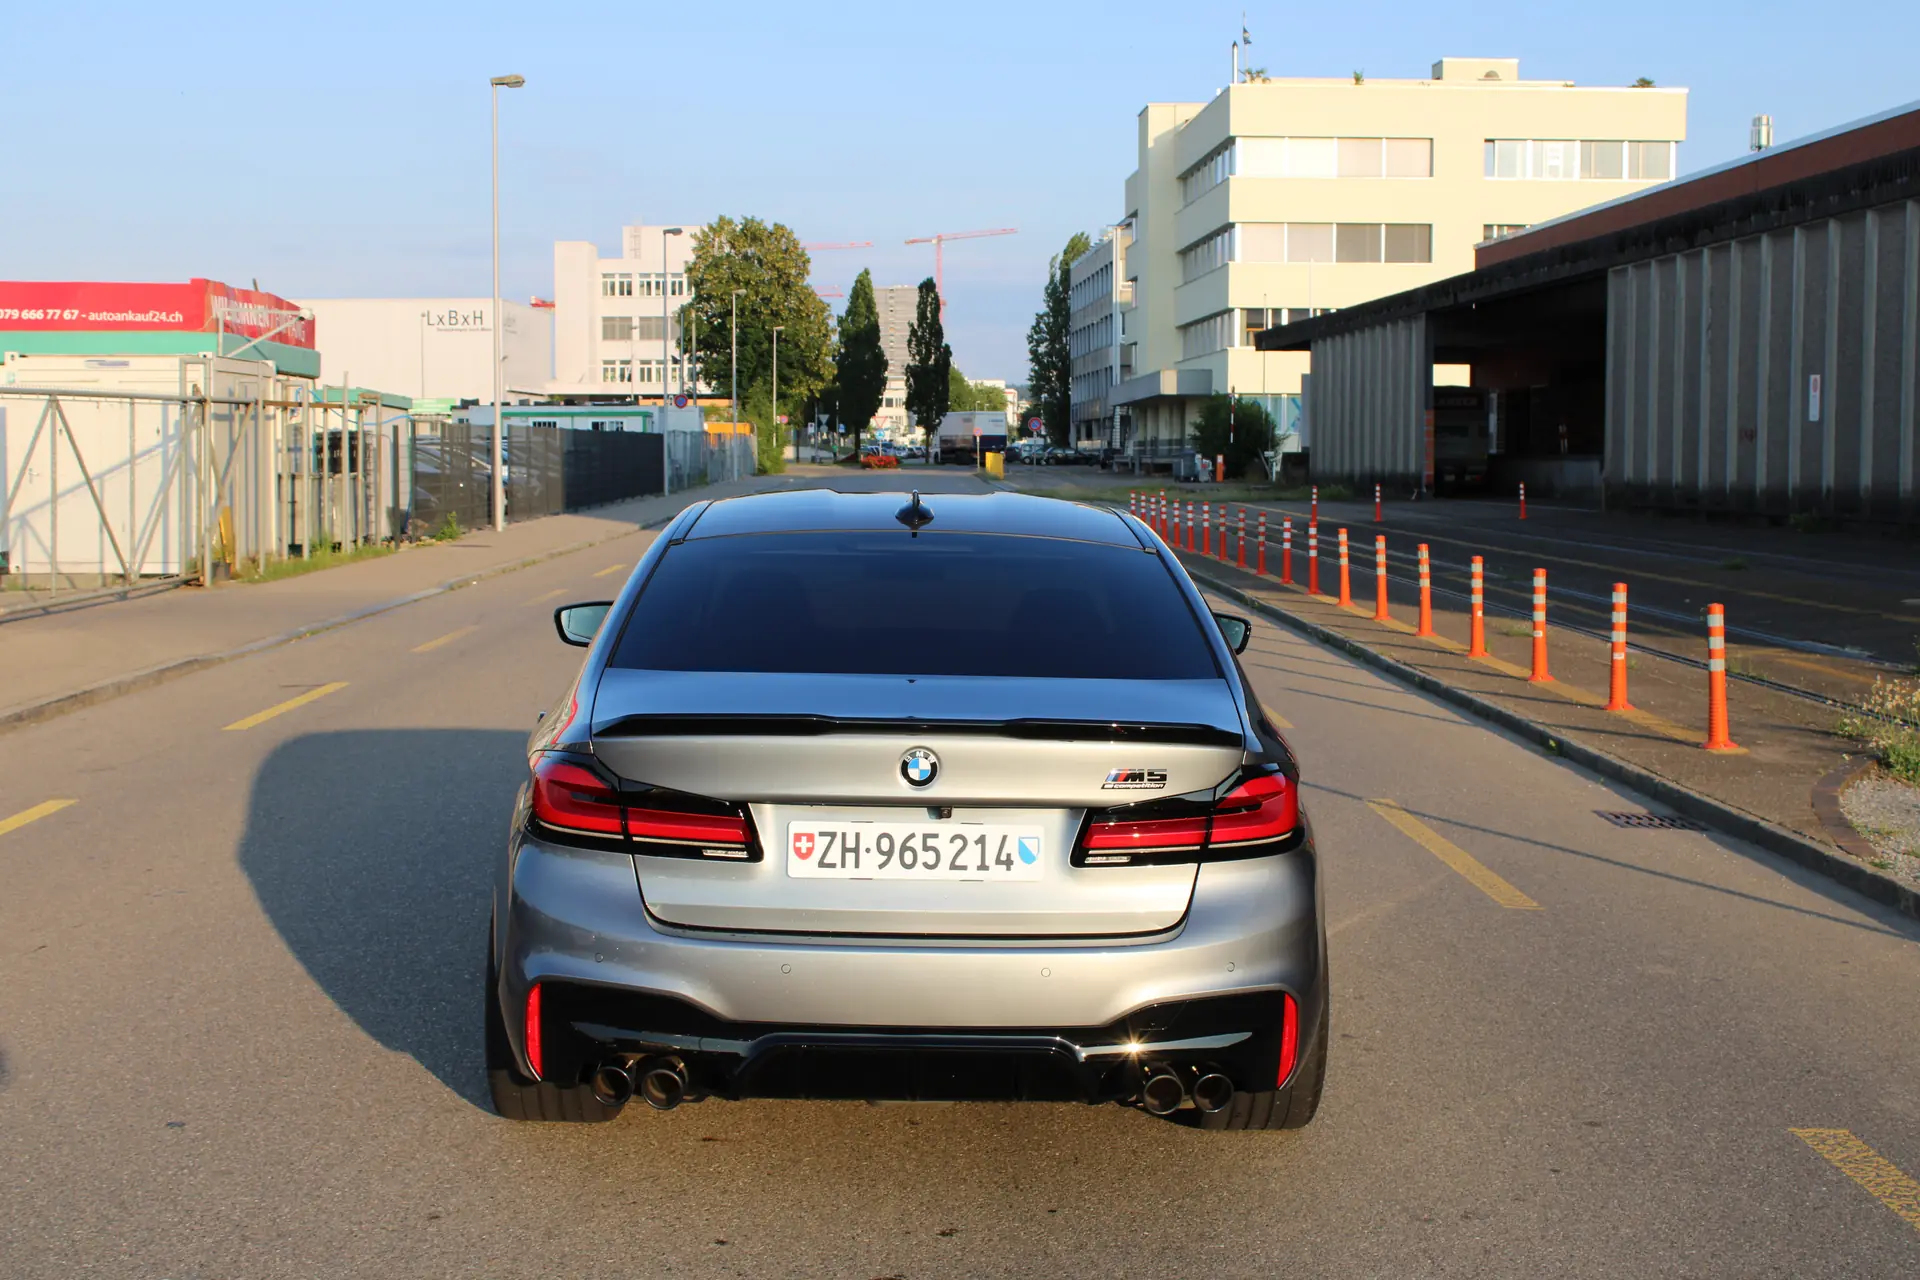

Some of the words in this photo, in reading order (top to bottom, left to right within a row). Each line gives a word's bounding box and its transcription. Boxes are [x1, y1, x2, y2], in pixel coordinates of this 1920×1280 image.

[21, 309, 44, 320] 666
[46, 309, 61, 320] 77
[63, 309, 79, 320] 67
[88, 309, 183, 322] autoankauf24.ch
